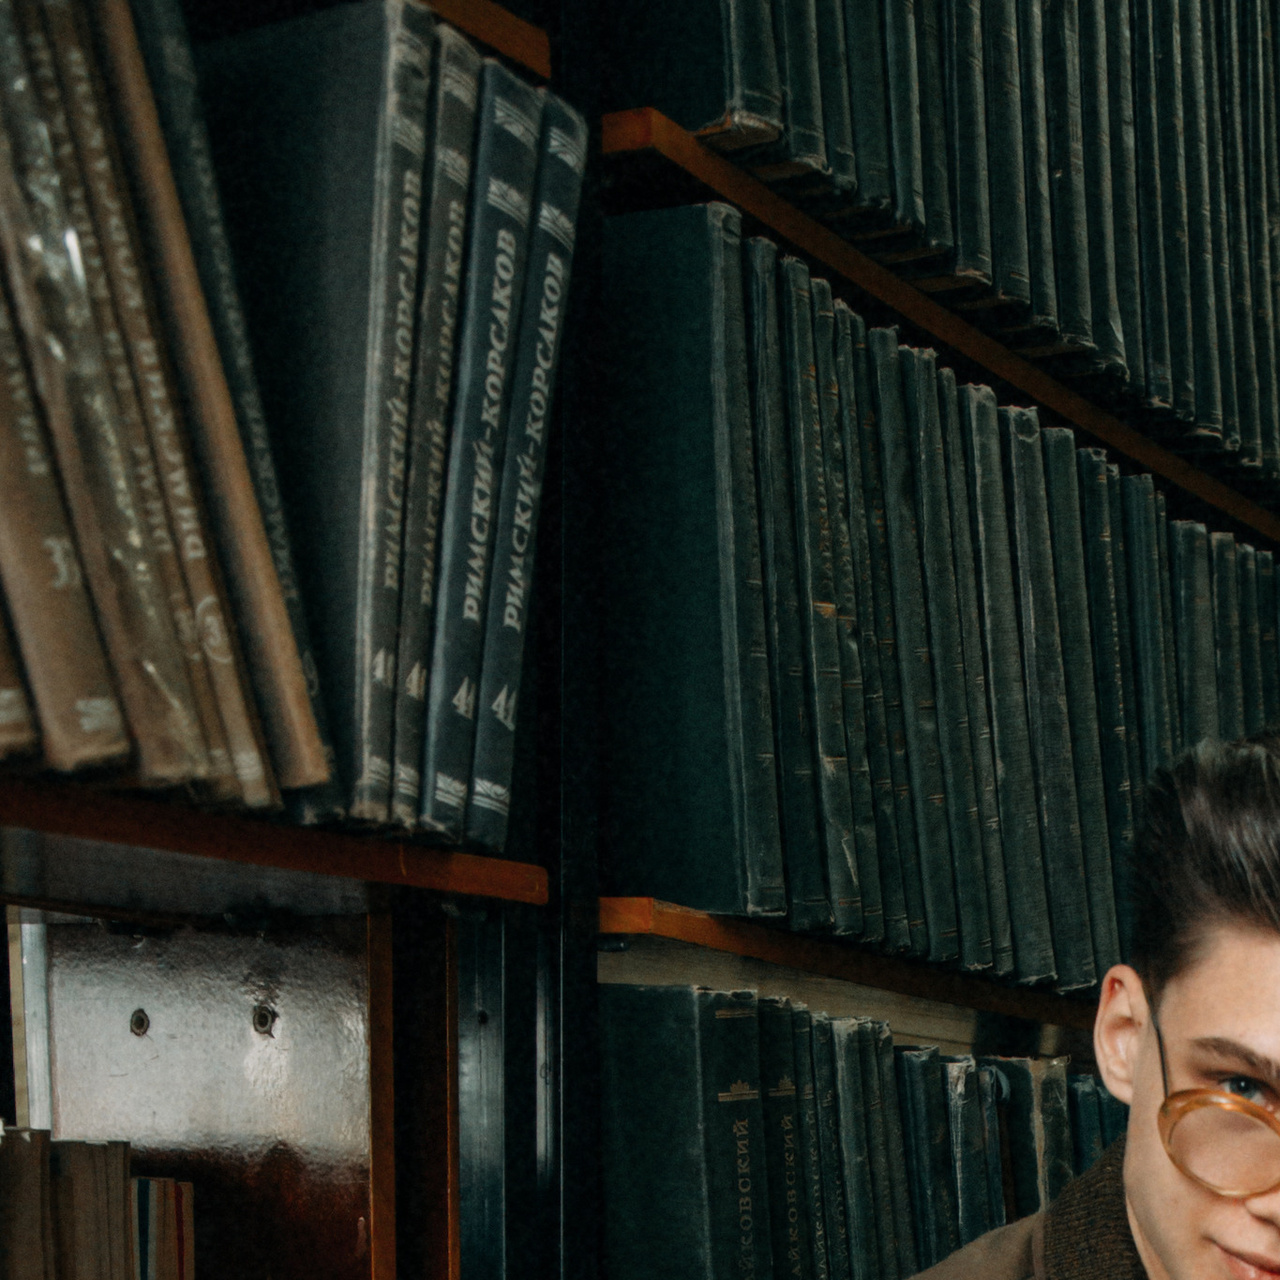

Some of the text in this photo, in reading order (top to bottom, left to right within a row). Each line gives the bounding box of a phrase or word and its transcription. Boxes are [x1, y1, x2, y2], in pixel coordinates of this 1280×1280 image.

[384, 169, 421, 590] РИМСКИЙ-КОРСАКОВ
[463, 228, 516, 623] РИМСКИЙ-КОРСАКОВ
[503, 252, 564, 635] РИМСКИЙ-КОРСАКОВ
